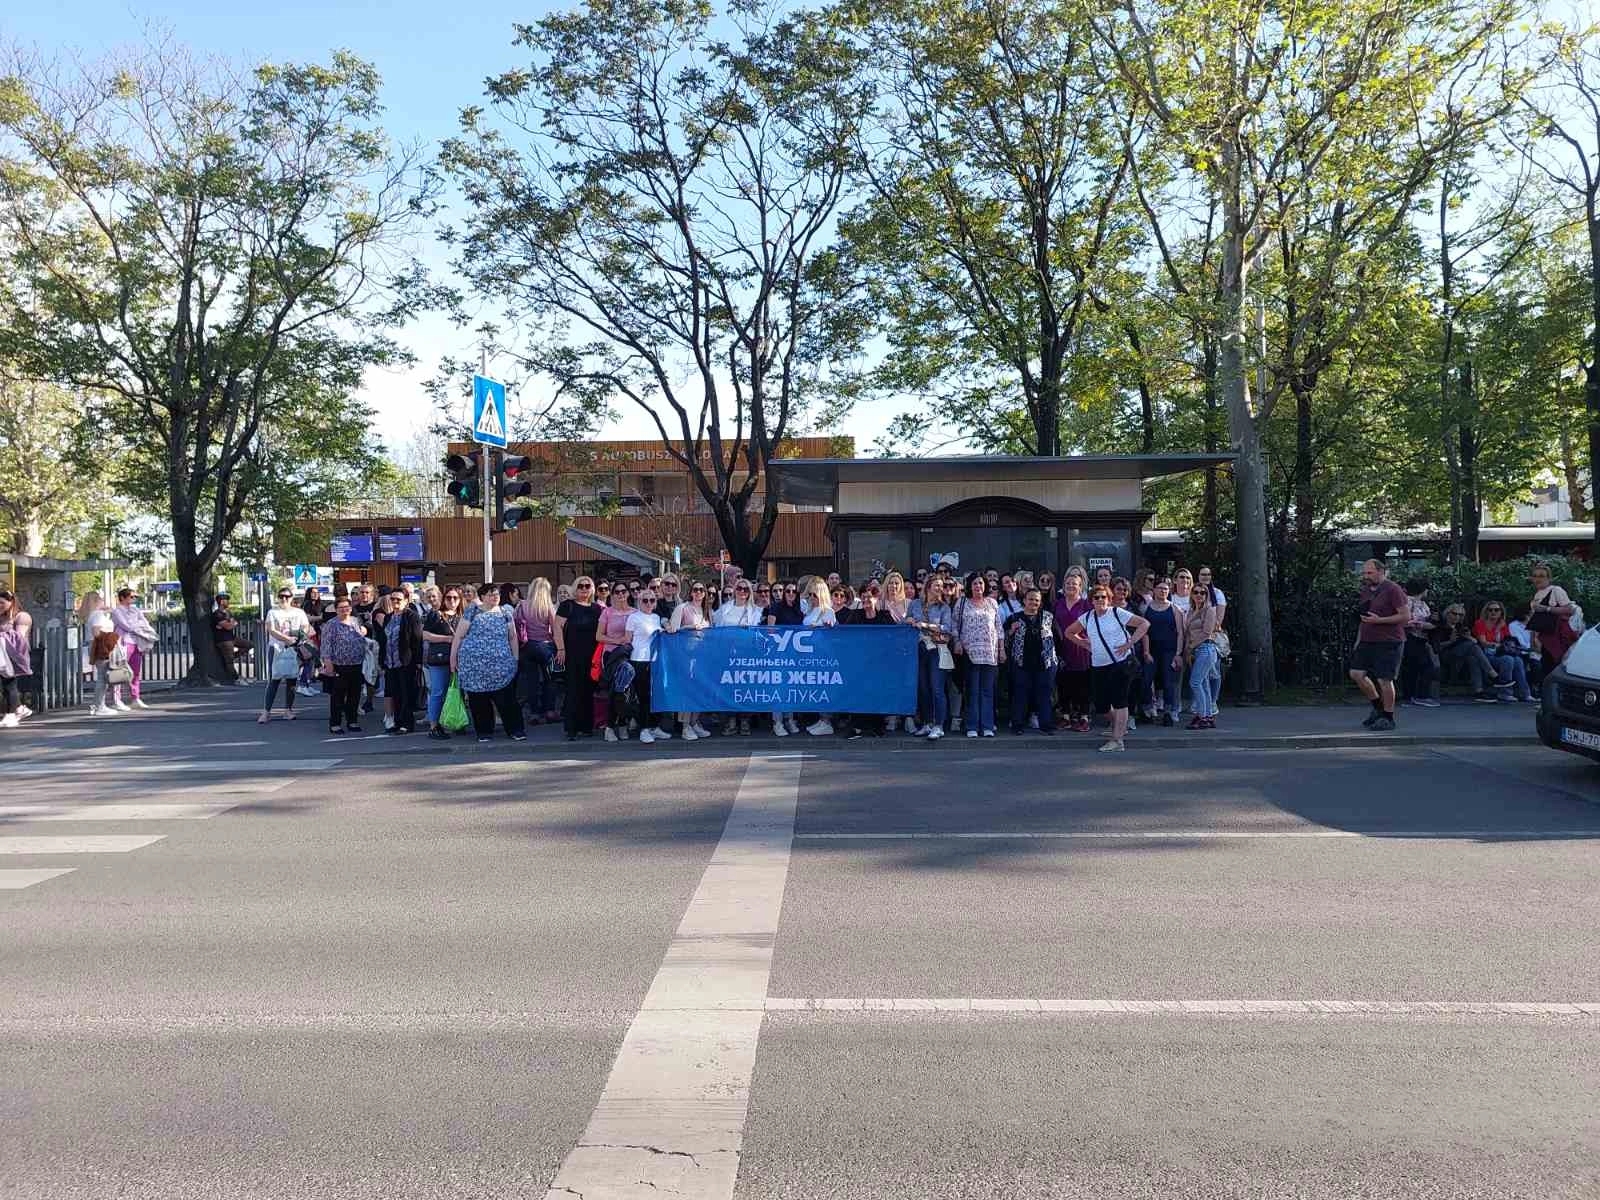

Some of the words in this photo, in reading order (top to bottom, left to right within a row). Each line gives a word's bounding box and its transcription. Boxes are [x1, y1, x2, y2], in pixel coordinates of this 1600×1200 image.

[769, 630, 814, 652] УС
[728, 658, 796, 666] УЈЕДИЊЕНА
[798, 658, 840, 667] СРПСКА
[720, 670, 783, 684] АКТИВ
[787, 671, 844, 685] ЖЕНА
[734, 689, 782, 703] БАЊА
[786, 689, 830, 703] ЛУКА
